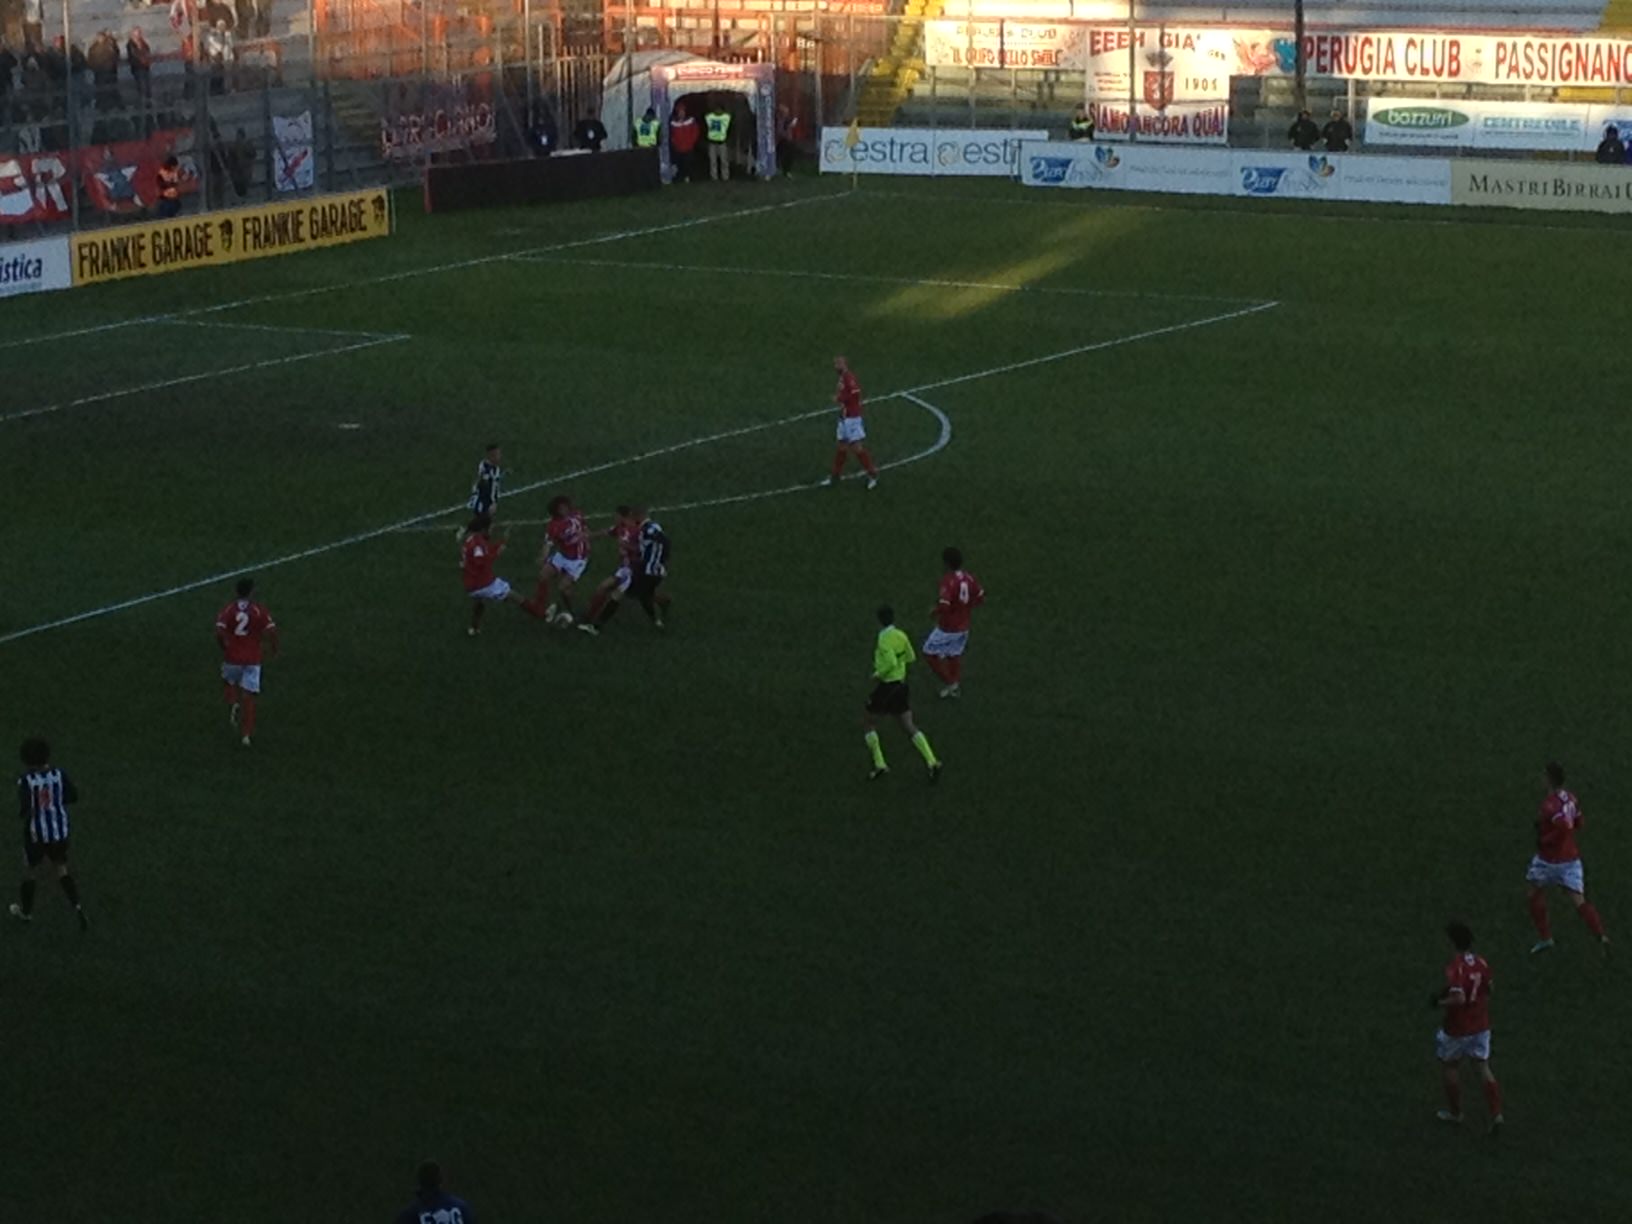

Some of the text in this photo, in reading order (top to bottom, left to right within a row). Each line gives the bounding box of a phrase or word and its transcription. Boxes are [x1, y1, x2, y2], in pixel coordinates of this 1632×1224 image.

[1303, 36, 1461, 78] PERUGIA CLUB
[850, 138, 928, 163] estra
[78, 198, 367, 279] FRANKIE GARAGE FRANKIE GARAGE
[235, 611, 249, 636] 2
